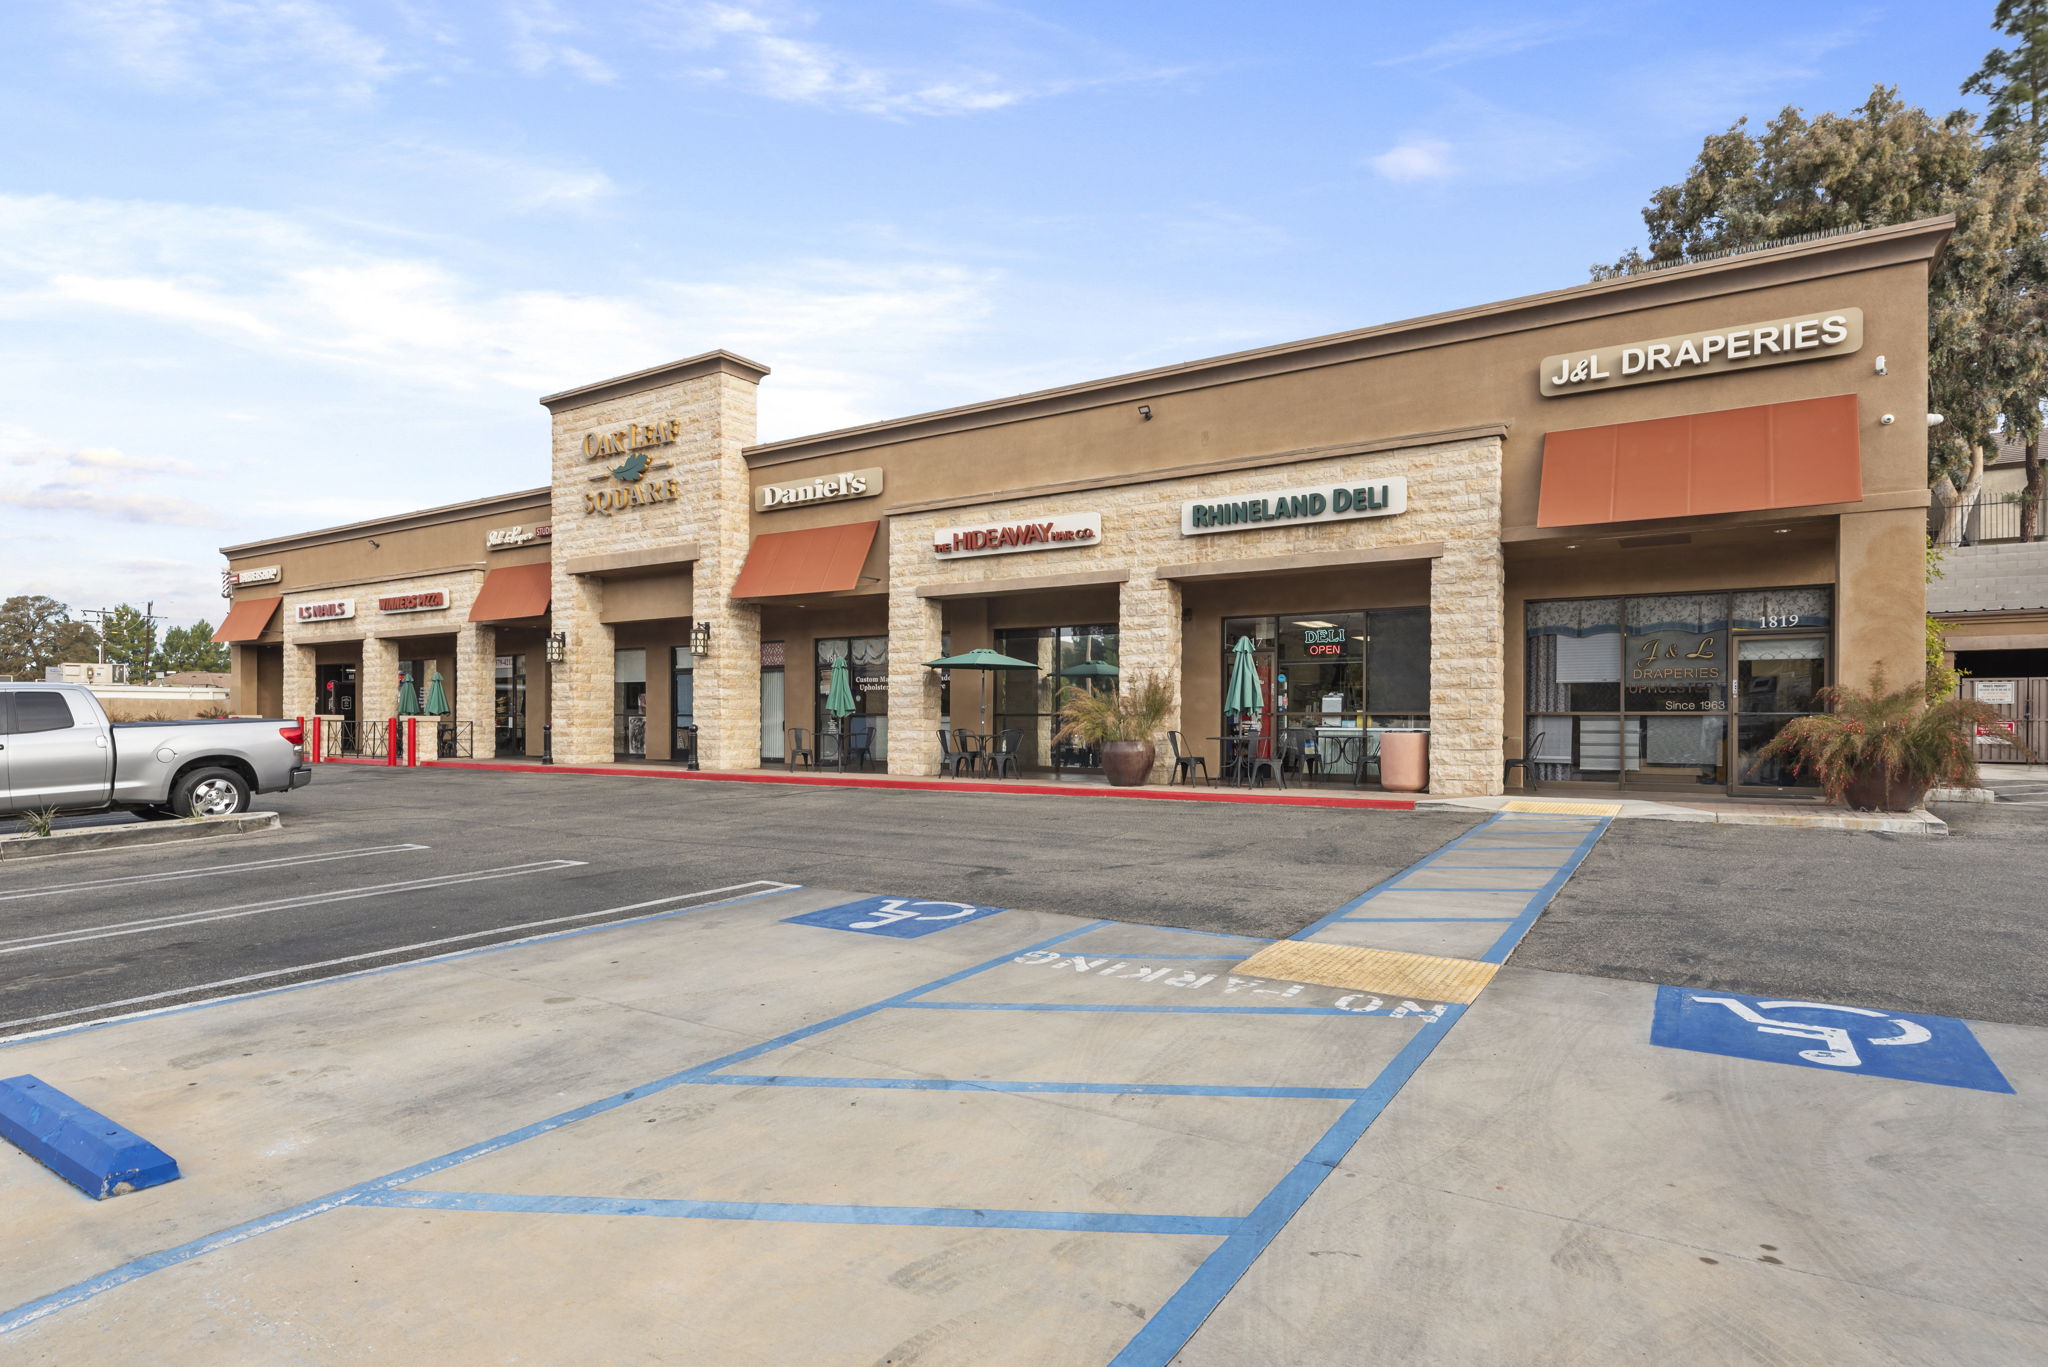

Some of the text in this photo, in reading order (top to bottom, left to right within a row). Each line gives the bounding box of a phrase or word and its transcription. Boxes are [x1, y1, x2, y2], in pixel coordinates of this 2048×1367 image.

[1551, 315, 1849, 386] J&L DRAPERIES
[581, 418, 681, 460] OAK LEAF
[582, 479, 680, 517] SQUARE
[762, 472, 867, 507] Daniel's
[1192, 485, 1389, 527] RHINELAND DELI
[933, 543, 952, 553] THE
[953, 522, 1054, 552] HIDEAWAY
[1051, 530, 1074, 542] HAIR
[313, 602, 346, 618] NAILS
[379, 592, 443, 611] WINNERS PIZZA
[1759, 614, 1799, 629] 1819
[1304, 628, 1346, 644] DELI
[1309, 645, 1341, 655] OPEN
[1633, 667, 1719, 680] DRAPERIES
[859, 683, 889, 692] Upholster
[1665, 700, 1726, 711] Since 1963
[1334, 993, 1451, 1024] NO
